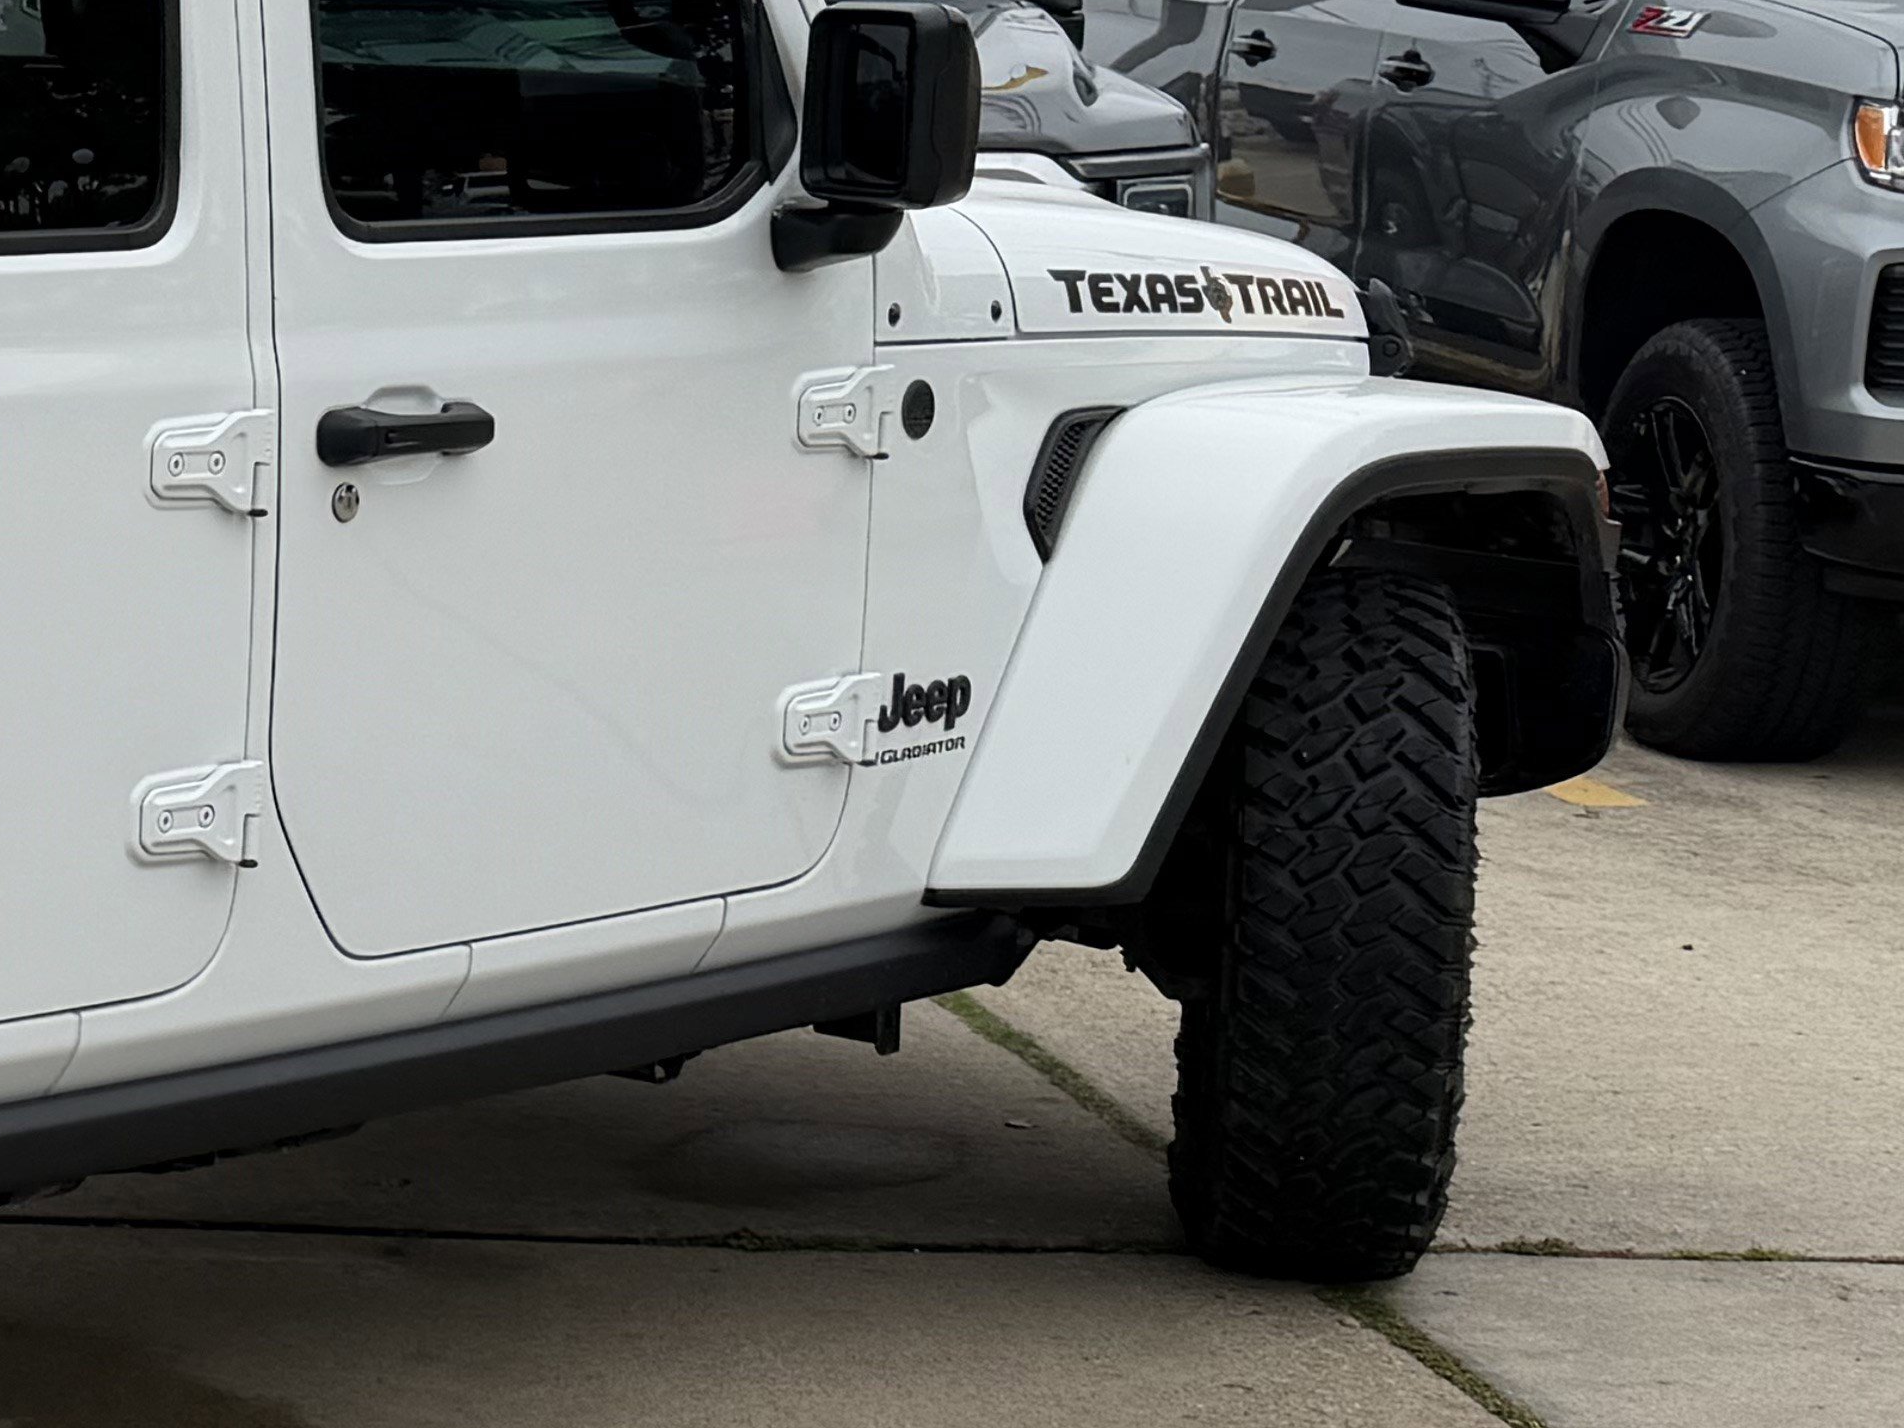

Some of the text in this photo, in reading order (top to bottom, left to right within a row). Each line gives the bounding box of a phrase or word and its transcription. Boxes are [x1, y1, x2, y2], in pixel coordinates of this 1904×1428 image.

[1046, 269, 1345, 319] TEXAS TRAIL
[877, 672, 971, 733] Jeep
[879, 736, 966, 765] GLADIATOR
